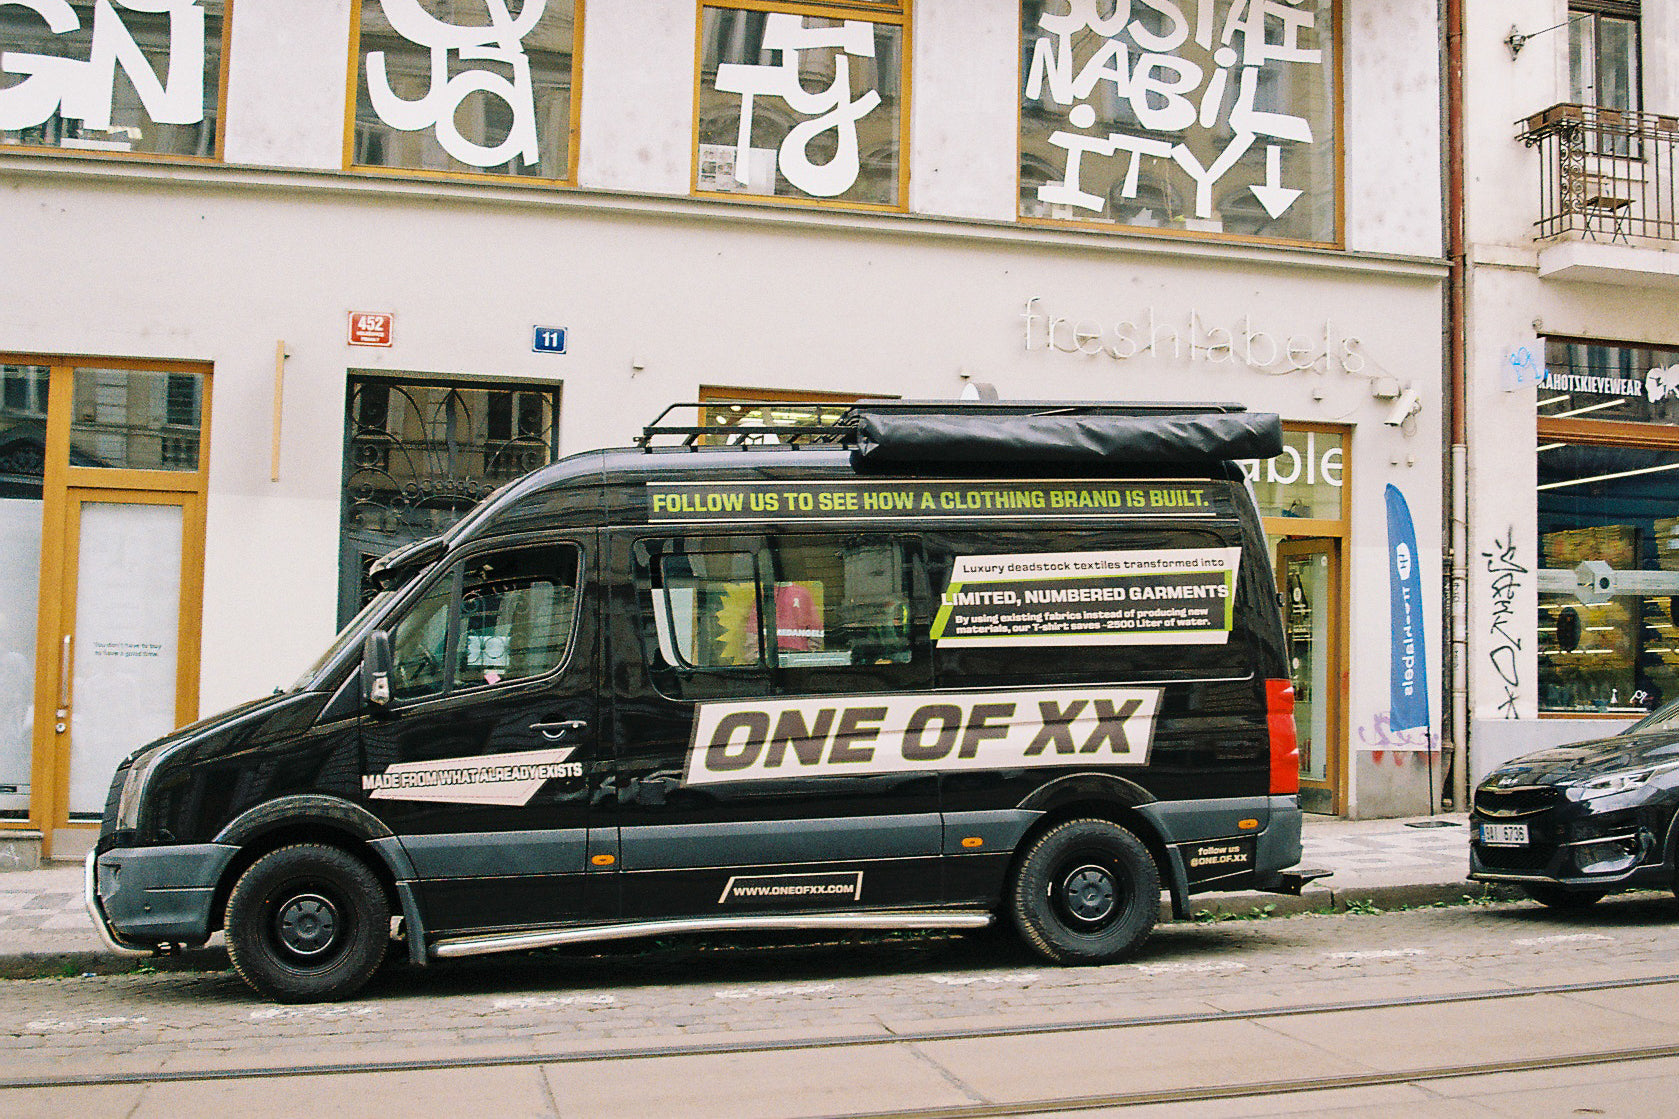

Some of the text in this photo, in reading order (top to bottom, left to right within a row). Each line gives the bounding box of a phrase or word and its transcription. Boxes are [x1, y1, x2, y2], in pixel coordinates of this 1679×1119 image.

[358, 315, 384, 331] 452
[542, 332, 558, 347] 11
[1020, 296, 1365, 373] freshlabels
[653, 489, 1209, 512] FOLLOW US TO SEE HOW A CLOTHING BRAND IS BUILT.
[963, 558, 1225, 574] Luxury deadstock textiles transformed into
[941, 585, 1229, 606] LIMITED, NUMBERED GARMENTS
[955, 608, 1209, 626] By using existing fabrics instead of producing new
[956, 624, 1011, 634] materials,
[1032, 622, 1069, 632] T-shirt
[1071, 622, 1100, 630] saves
[1136, 618, 1163, 628] Liter
[1164, 617, 1176, 627] of
[1176, 617, 1212, 627] water.
[705, 699, 1143, 772] ONE OF XX
[362, 762, 583, 790] MADE FROM WHAT ALREADY EXISTS
[1198, 846, 1227, 856] follow
[733, 884, 854, 896] WWW.ONEOFXX.COM
